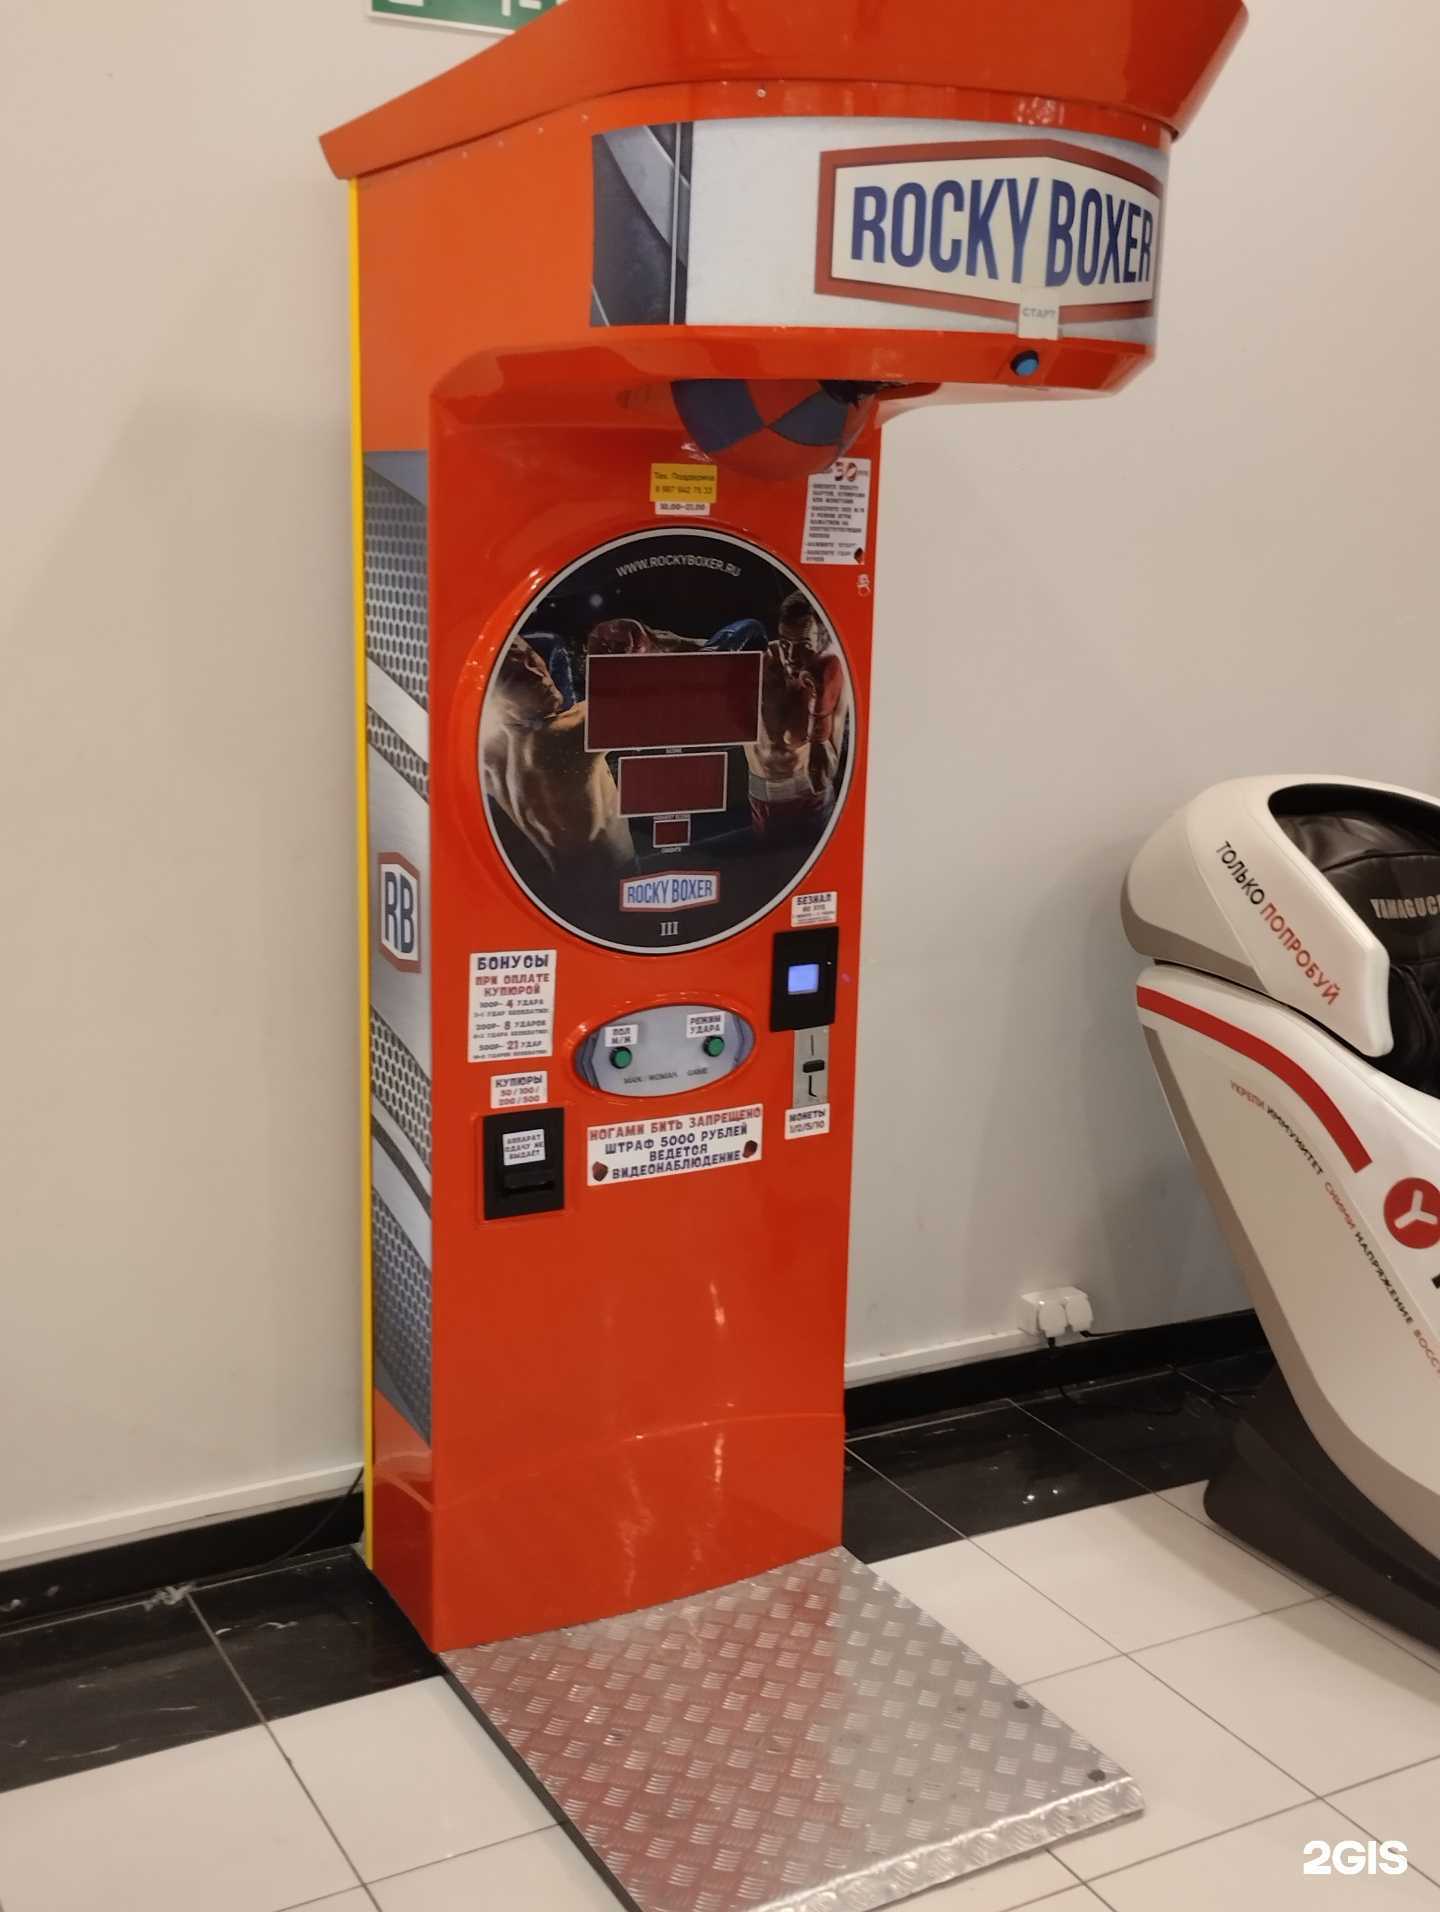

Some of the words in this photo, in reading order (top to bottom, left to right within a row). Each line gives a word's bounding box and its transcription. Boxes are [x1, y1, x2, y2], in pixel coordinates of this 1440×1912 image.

[851, 177, 1040, 284] ROCKY
[1045, 179, 1154, 288] BOXER
[616, 555, 742, 577] WWW.ROCKYBOXER.RU
[627, 879, 670, 905] ROCKY
[671, 878, 713, 904] BOXER
[384, 871, 415, 954] RB
[1217, 841, 1265, 905] ТОЛЬКО
[1259, 902, 1341, 1005] ПОПРОБУЙ
[660, 921, 679, 936] III
[477, 954, 549, 971] БОНУСЫ
[475, 975, 498, 986] ПРИ
[503, 973, 550, 984] ОПЛАТЕ
[484, 984, 541, 997] КУПЮРОЙ
[495, 1075, 543, 1088] КУПЮРЫ
[589, 1123, 645, 1141] НОГАМИ
[650, 1119, 683, 1133] БИТЬ
[689, 1107, 761, 1128] ЗАПРЕЩЕНО
[605, 1138, 655, 1155] ШТРАФ
[660, 1135, 696, 1147] 5000
[701, 1123, 748, 1142] РУБЛЕЙ
[612, 1150, 742, 1179] ВИДЕОНАБЛЮДЕНИЕ
[649, 1144, 708, 1162] ВЕДЕТСЯ
[1324, 1181, 1356, 1230] СНИМИ
[1355, 1230, 1415, 1324] НАПРЯЖЕНИЕ
